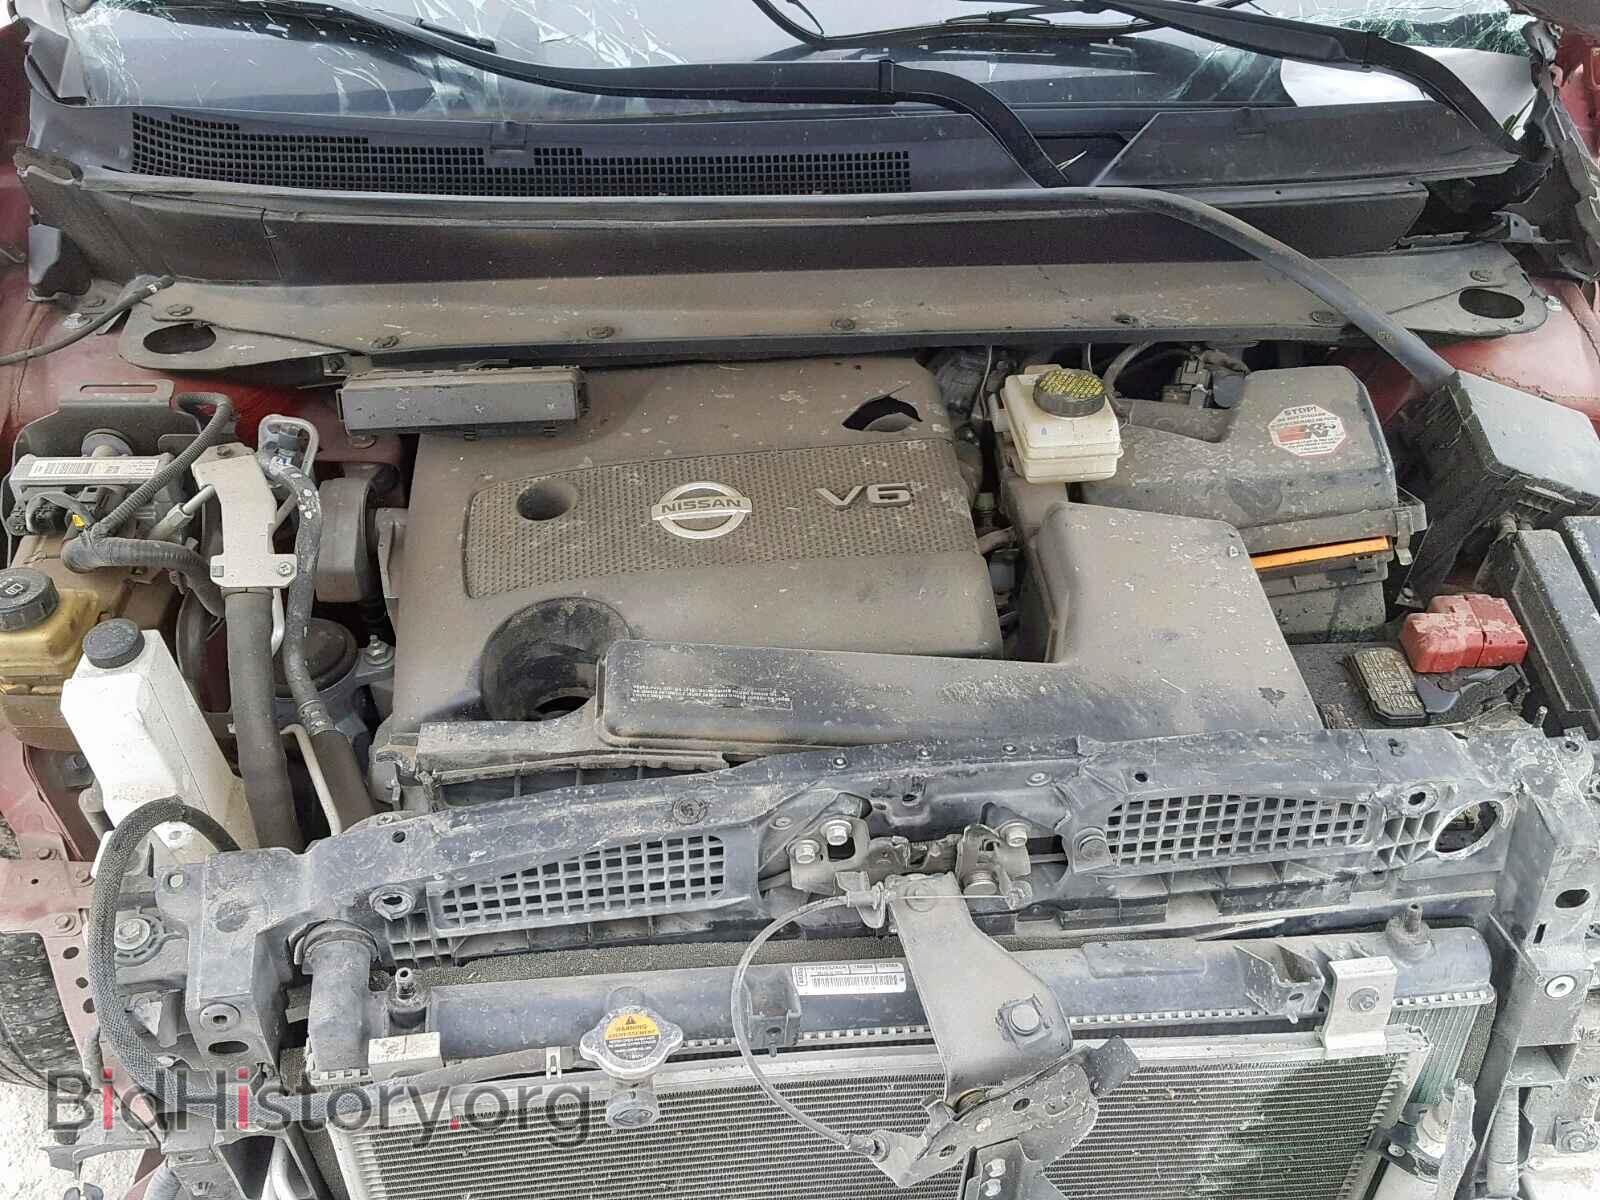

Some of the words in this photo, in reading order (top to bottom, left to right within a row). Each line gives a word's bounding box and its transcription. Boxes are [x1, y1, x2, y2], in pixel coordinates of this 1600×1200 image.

[1284, 406, 1317, 416] STOP!
[816, 482, 913, 511] V6
[661, 498, 741, 513] NISSAN
[616, 1023, 648, 1032] WARNING
